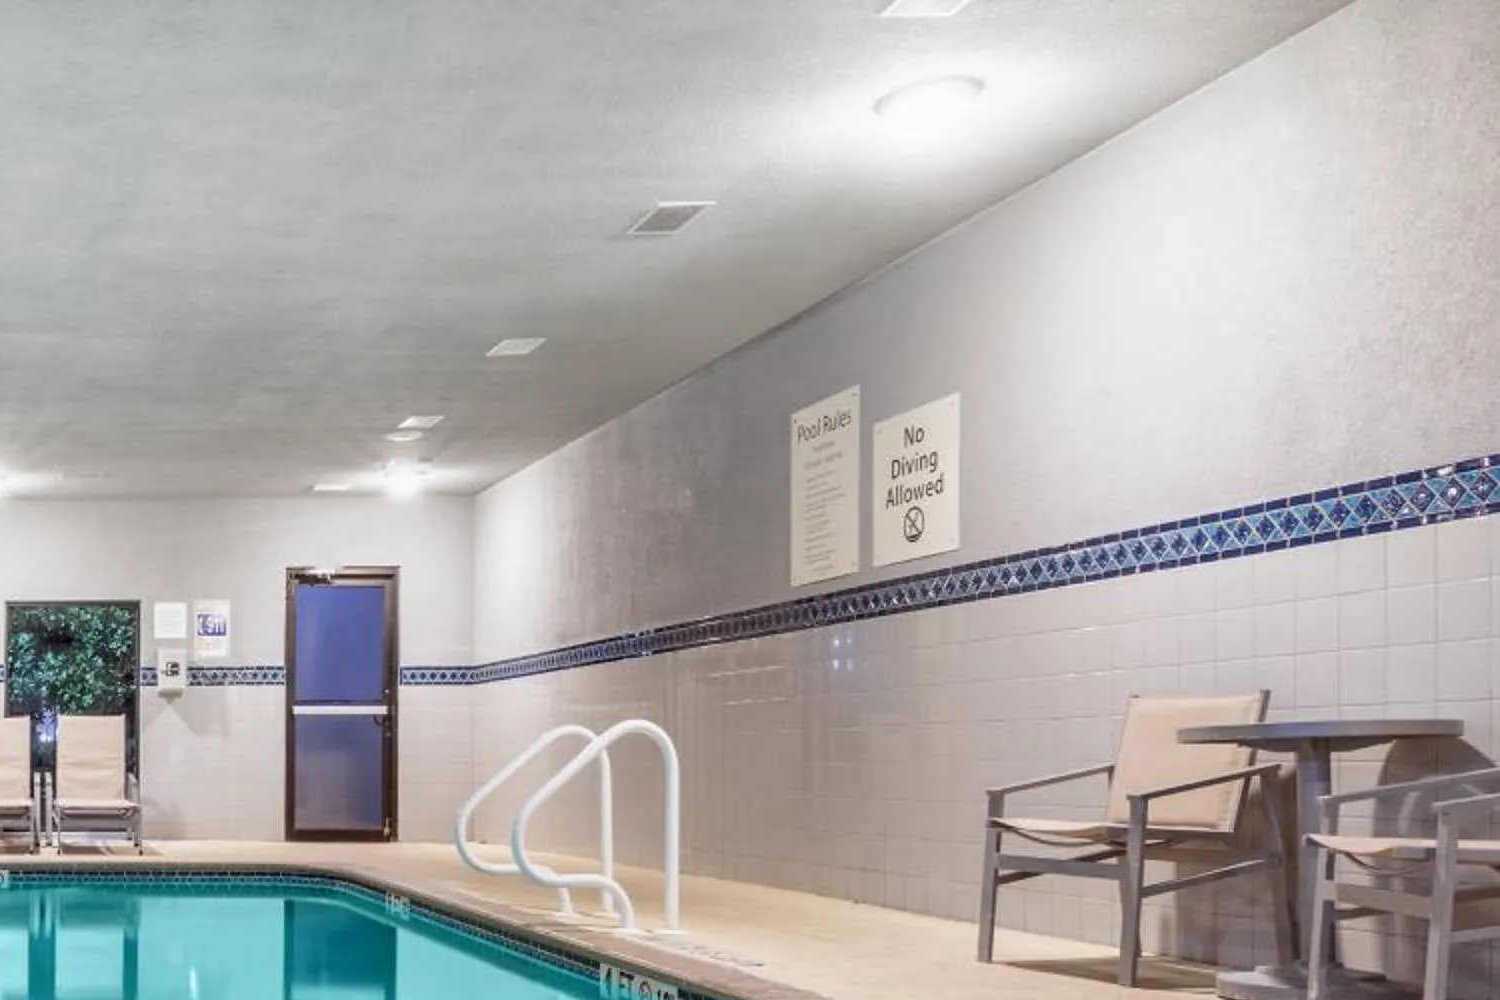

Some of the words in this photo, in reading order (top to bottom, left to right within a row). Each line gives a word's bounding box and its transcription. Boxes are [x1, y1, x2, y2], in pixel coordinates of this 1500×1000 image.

[797, 417, 820, 444] Pool
[822, 408, 853, 434] Rules
[903, 424, 925, 448] No
[891, 451, 938, 479] Diving
[885, 472, 945, 509] Allowed
